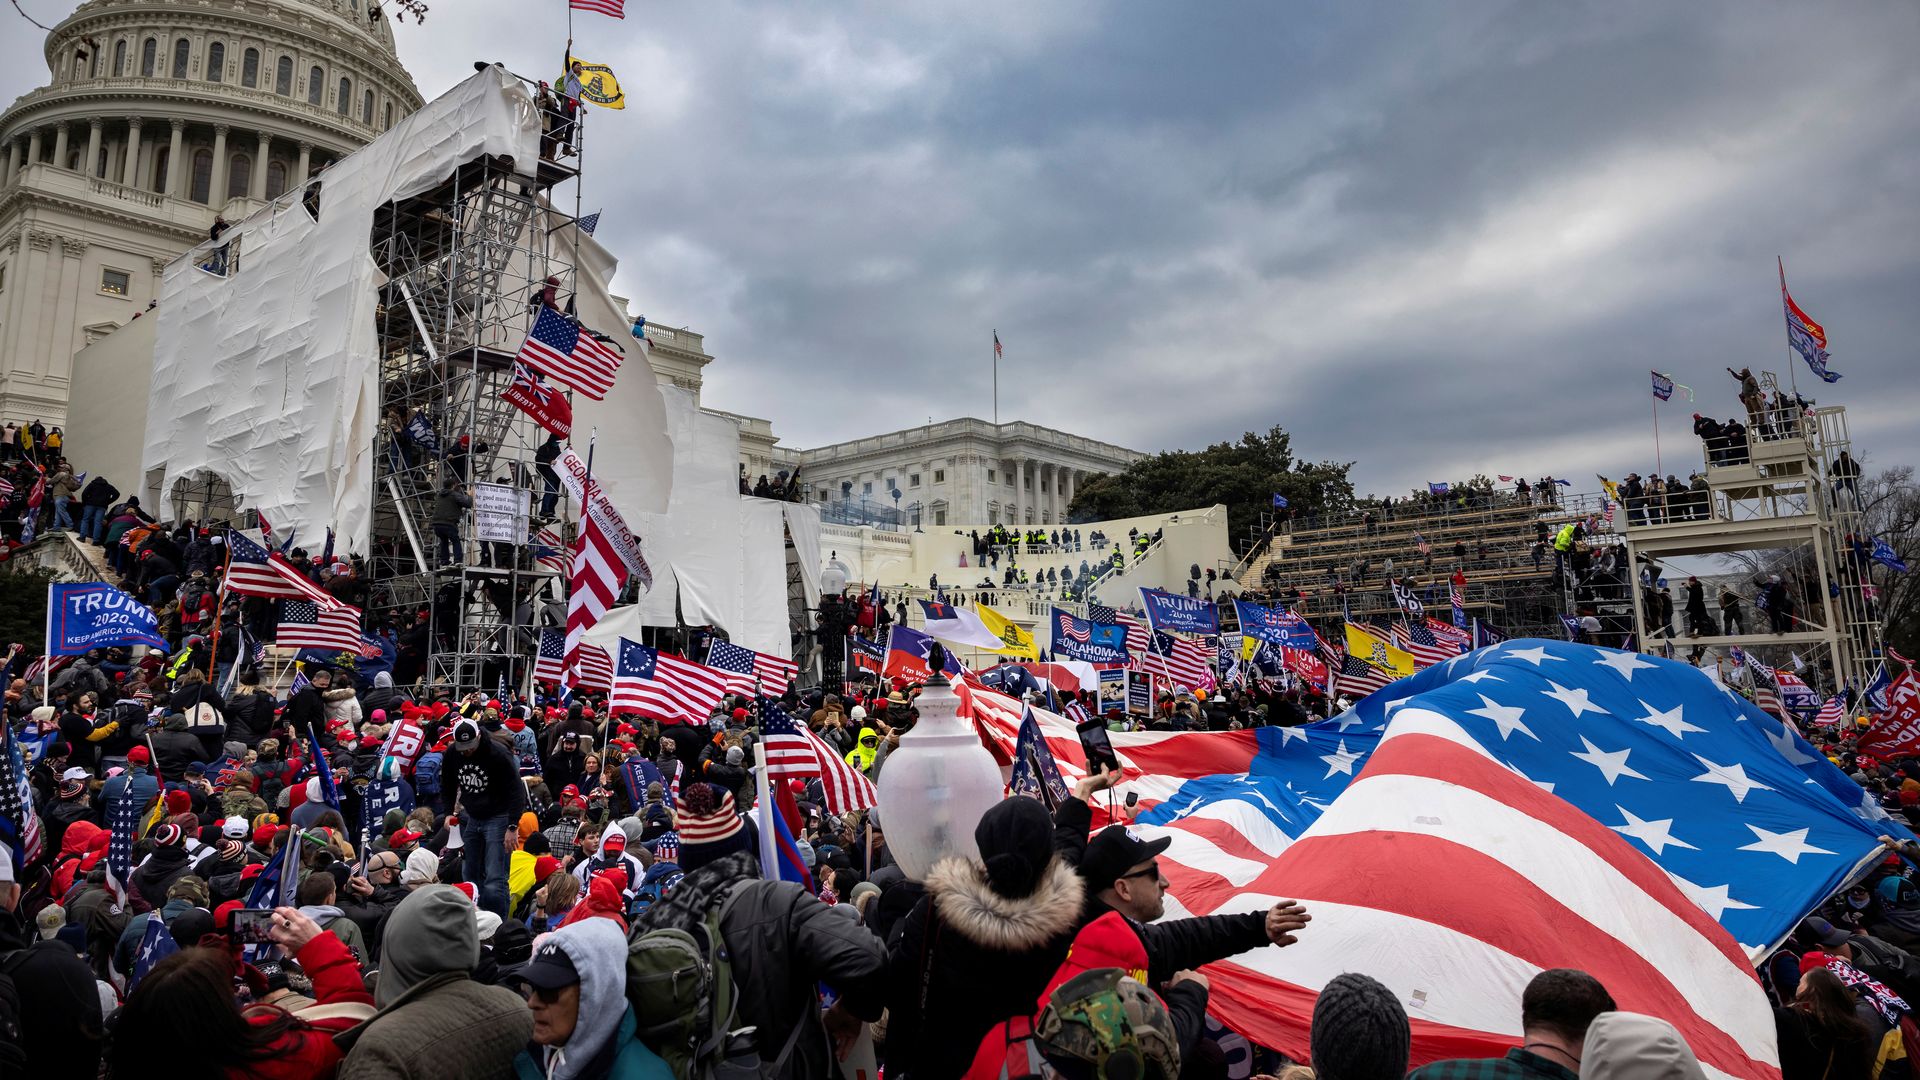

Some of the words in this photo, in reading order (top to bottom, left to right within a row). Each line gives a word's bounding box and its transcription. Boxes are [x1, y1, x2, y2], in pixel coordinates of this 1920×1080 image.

[507, 388, 538, 413] LIBERTY
[566, 475, 584, 500] Chines
[586, 504, 612, 536] American
[610, 533, 643, 576] Republicans
[596, 496, 622, 526] FIGHT
[618, 526, 635, 549] FOR
[70, 592, 158, 625] TRUMP
[1151, 594, 1209, 611] TRUMP
[67, 633, 90, 644] KEEP
[90, 627, 123, 641] AMERICA
[1062, 638, 1119, 657] OKLAHOMA
[1066, 648, 1080, 658] FOR
[1083, 654, 1113, 662] TRUMP
[902, 666, 914, 674] I'm
[462, 772, 483, 788] 1776
[634, 764, 646, 786] KEEP
